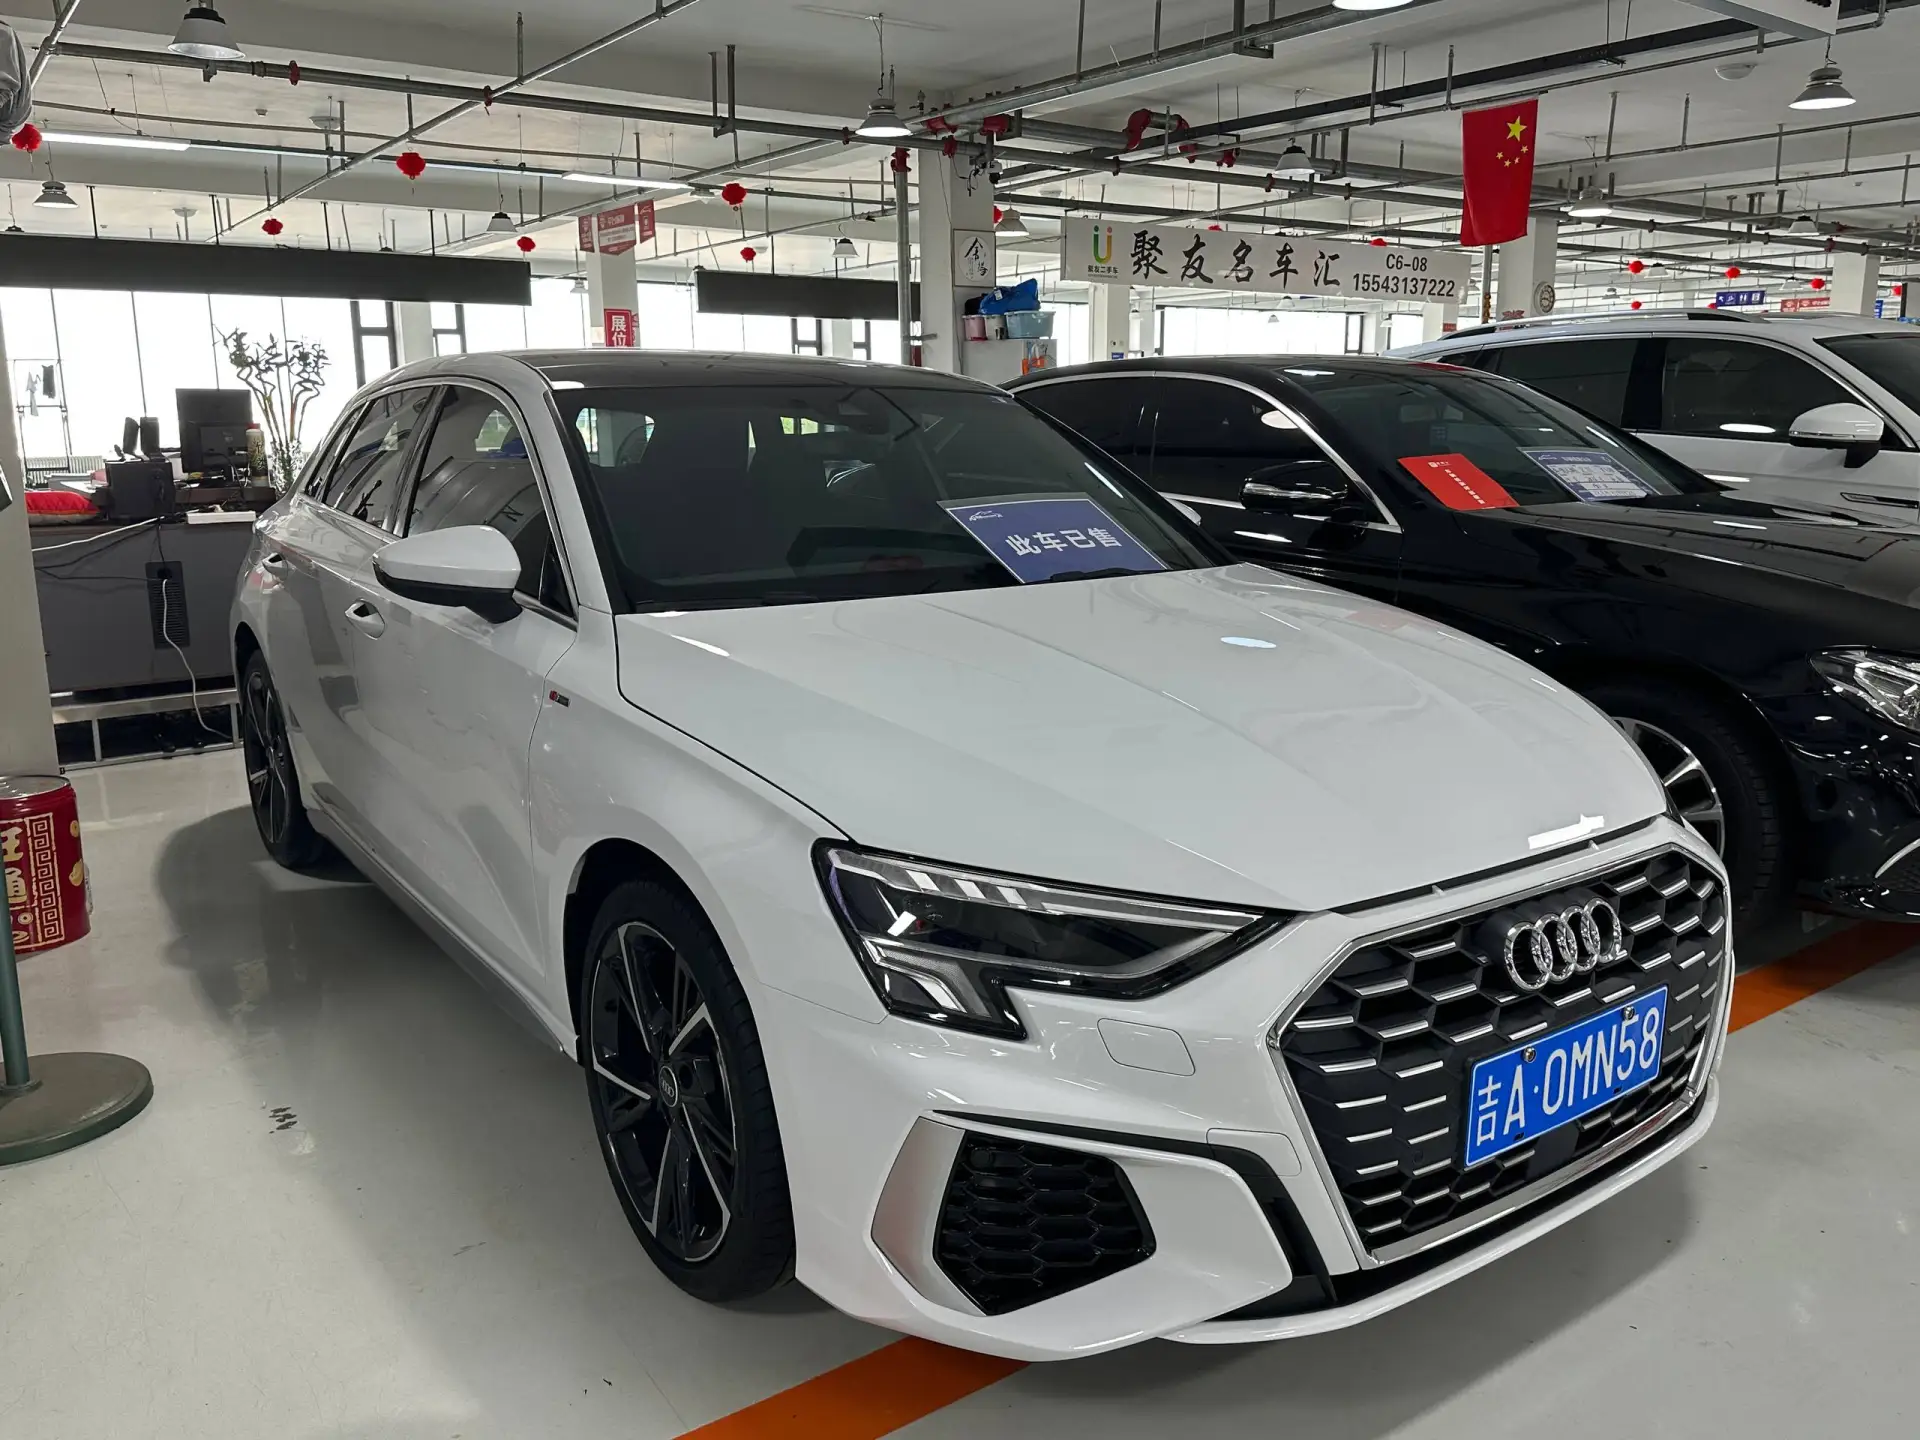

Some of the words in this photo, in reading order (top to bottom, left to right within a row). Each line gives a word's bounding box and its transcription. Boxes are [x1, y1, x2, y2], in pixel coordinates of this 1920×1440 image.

[1130, 229, 1341, 290] 聚友名车汇
[1385, 253, 1428, 272] C6-08
[1353, 272, 1455, 298] 15543137222
[611, 315, 628, 347] 展位
[1005, 527, 1122, 556] 此车已售
